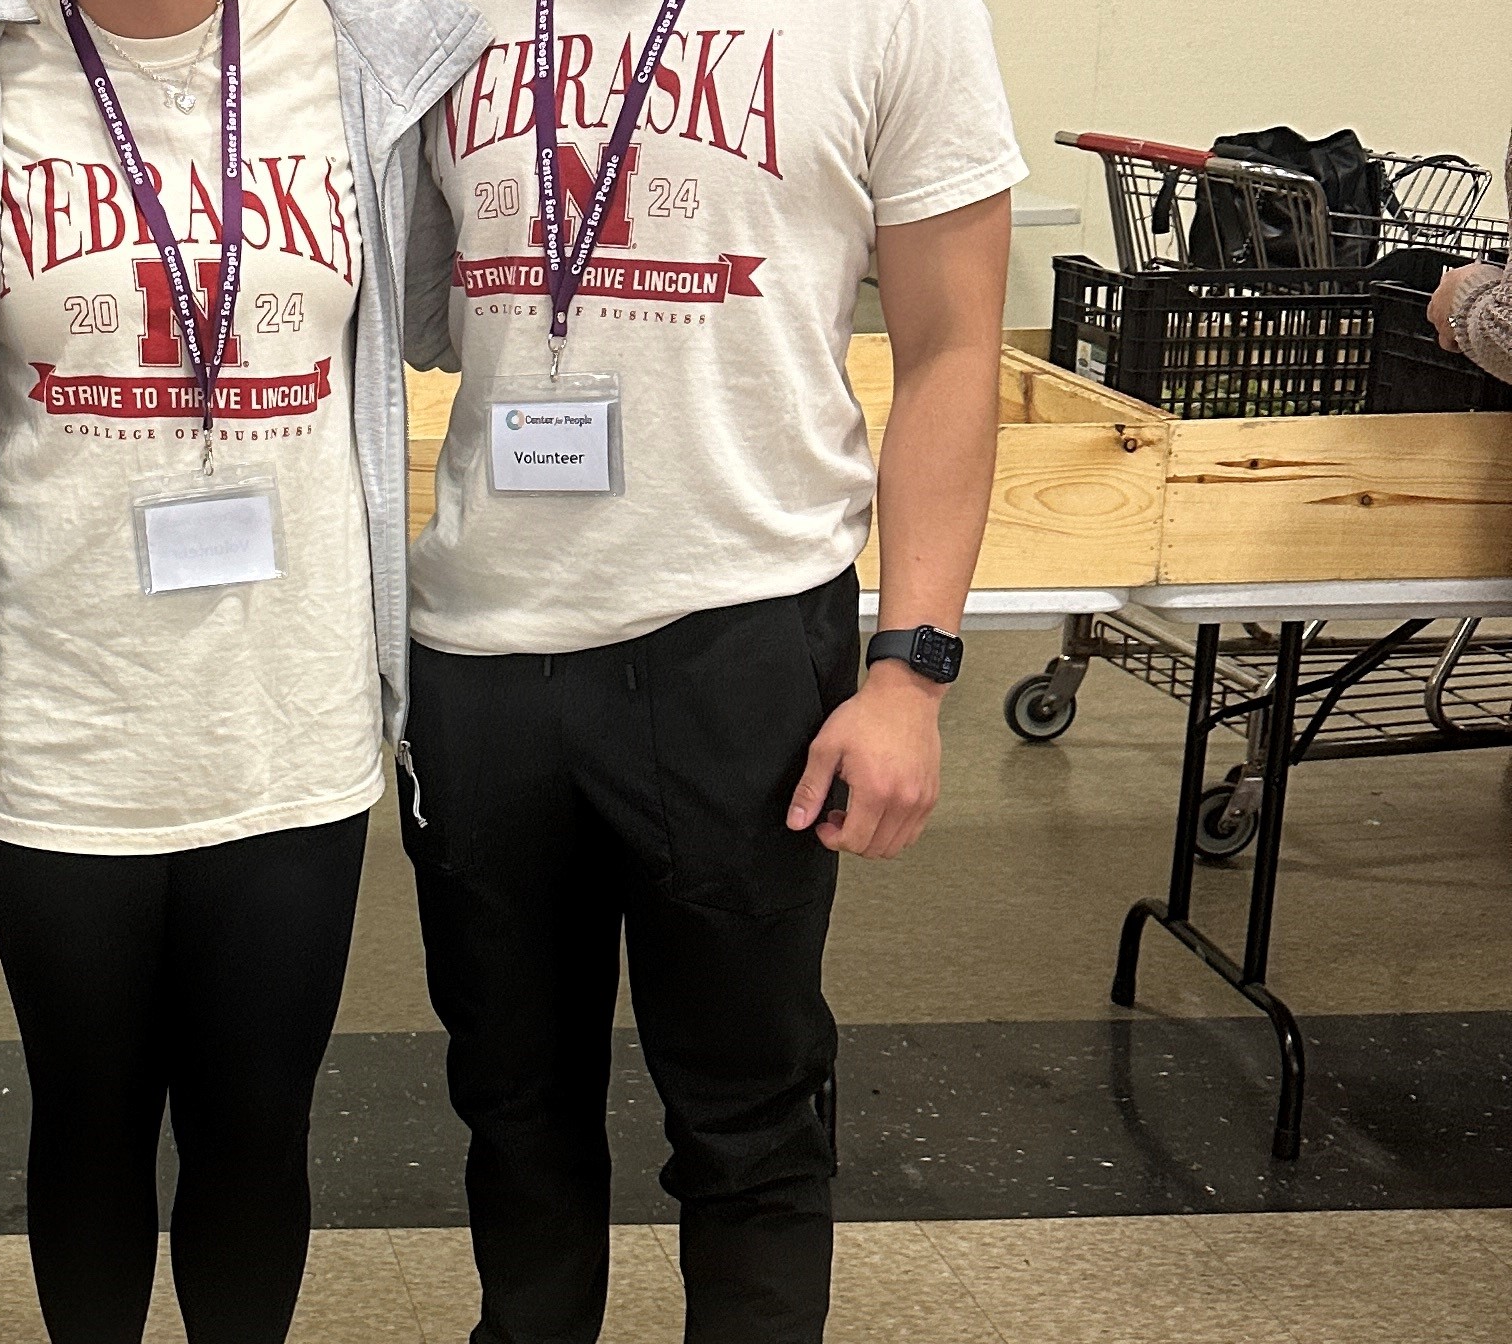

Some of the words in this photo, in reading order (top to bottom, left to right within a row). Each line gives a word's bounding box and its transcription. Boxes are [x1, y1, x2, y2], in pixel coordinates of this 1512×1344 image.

[538, 9, 549, 30] for
[537, 32, 549, 78] People
[637, 35, 663, 83] Center
[657, 11, 673, 33] for
[226, 64, 238, 107] People
[94, 77, 117, 120] Center
[111, 120, 126, 142] for
[120, 142, 143, 186] People
[226, 109, 237, 131] for
[226, 131, 238, 178] Center
[542, 148, 553, 197] Center
[474, 179, 520, 220] 20
[528, 142, 641, 249] N
[647, 178, 700, 219] 24
[546, 199, 556, 221] for
[571, 228, 595, 275] Center
[587, 204, 603, 227] for
[595, 155, 619, 202] People
[223, 244, 237, 291] People
[547, 224, 561, 271] People
[466, 265, 517, 289] STRIV
[519, 266, 544, 287] TO
[579, 268, 625, 290] RIVE
[633, 270, 718, 293] LINCOLN
[64, 293, 119, 335] 20
[131, 258, 242, 368] N
[254, 292, 305, 334] 24
[164, 245, 183, 293] Center
[178, 294, 190, 317] for
[185, 317, 201, 364] People
[221, 294, 232, 316] for
[475, 305, 538, 317] COLGE
[600, 307, 707, 325] BUSINESS
[213, 319, 228, 366] Center
[51, 385, 123, 409] STRIVE
[131, 387, 158, 409] TO
[250, 382, 317, 409] LINCOLN
[64, 424, 156, 440] COLLEGE
[175, 428, 199, 440] OF
[220, 426, 313, 441] BUSINESS
[525, 414, 554, 425] Center
[554, 417, 563, 426] for
[564, 414, 593, 427] People
[513, 451, 585, 464] Volunteer
